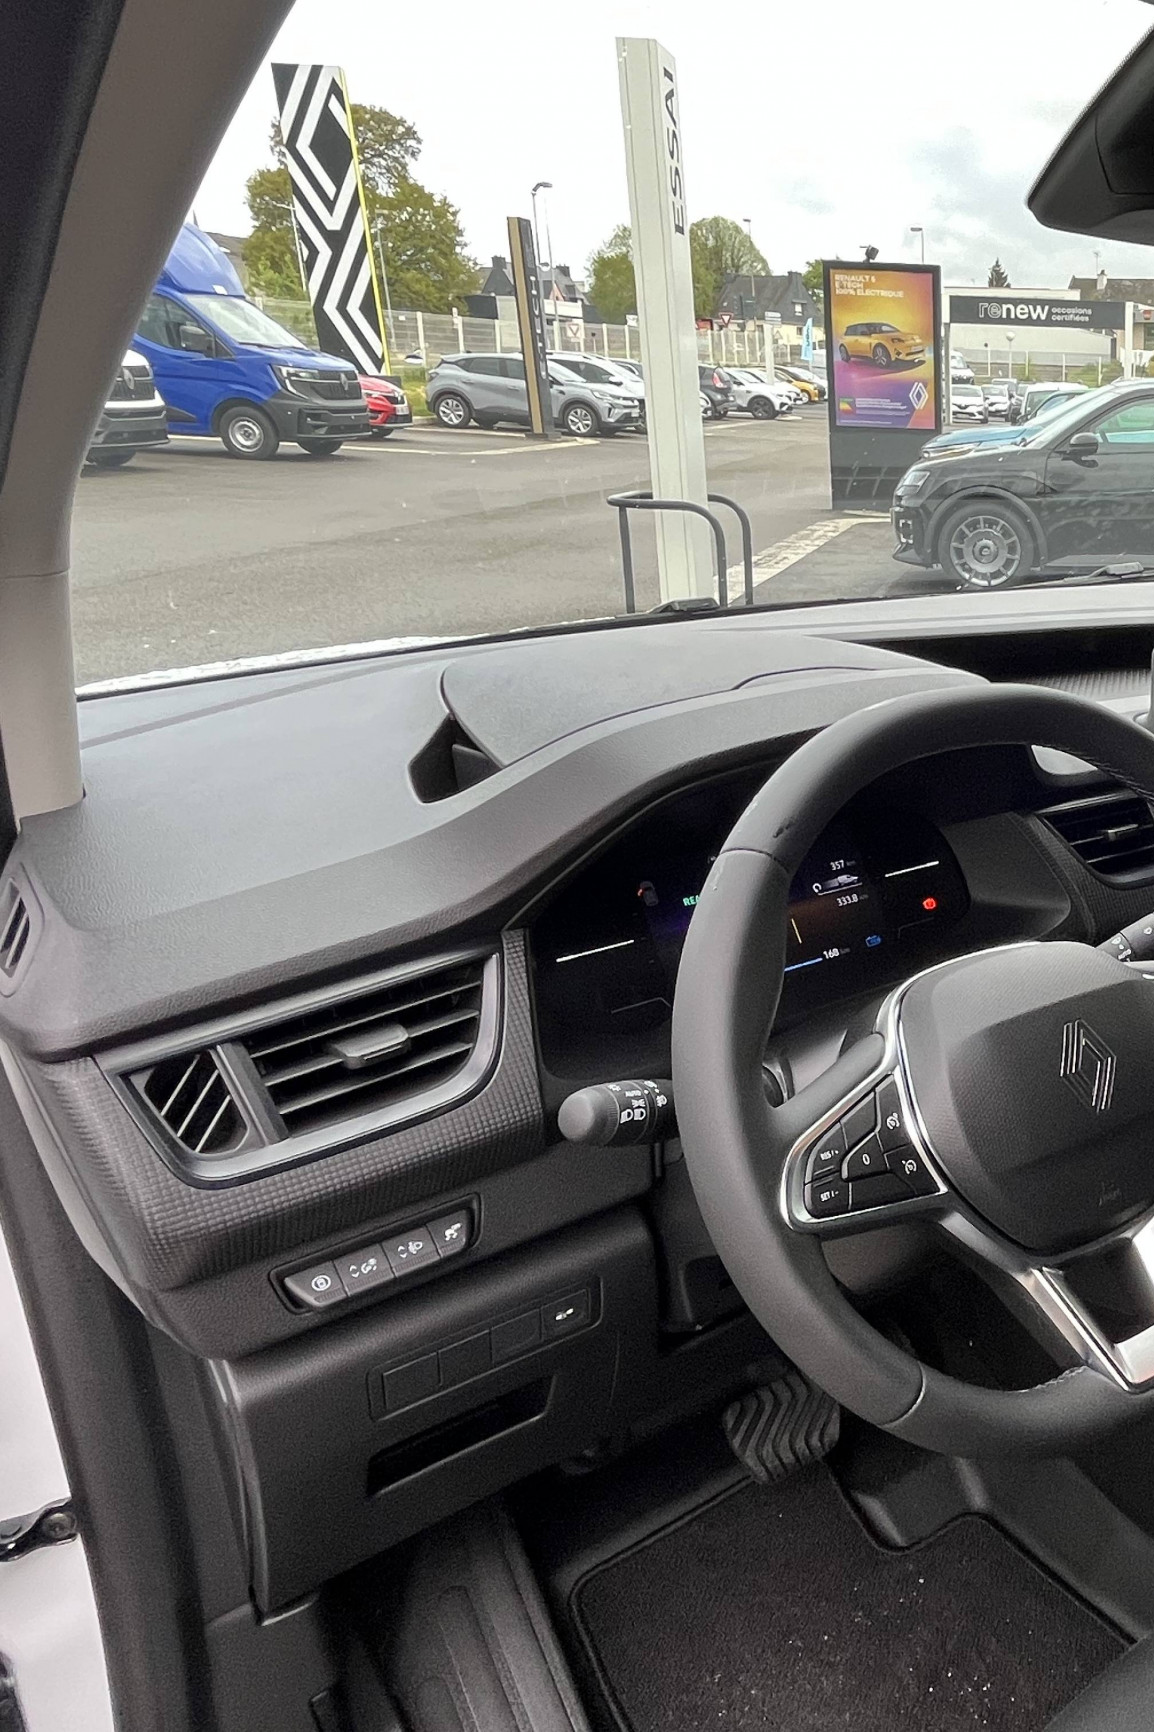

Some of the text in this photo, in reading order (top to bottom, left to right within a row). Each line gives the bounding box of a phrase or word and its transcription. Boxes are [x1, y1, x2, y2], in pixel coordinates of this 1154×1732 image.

[662, 66, 686, 236] ESSAI
[834, 274, 871, 282] RENAULT
[978, 302, 1050, 321] renew
[1051, 306, 1093, 315] occasions
[1051, 314, 1090, 322] certifiées
[830, 859, 845, 871] 357
